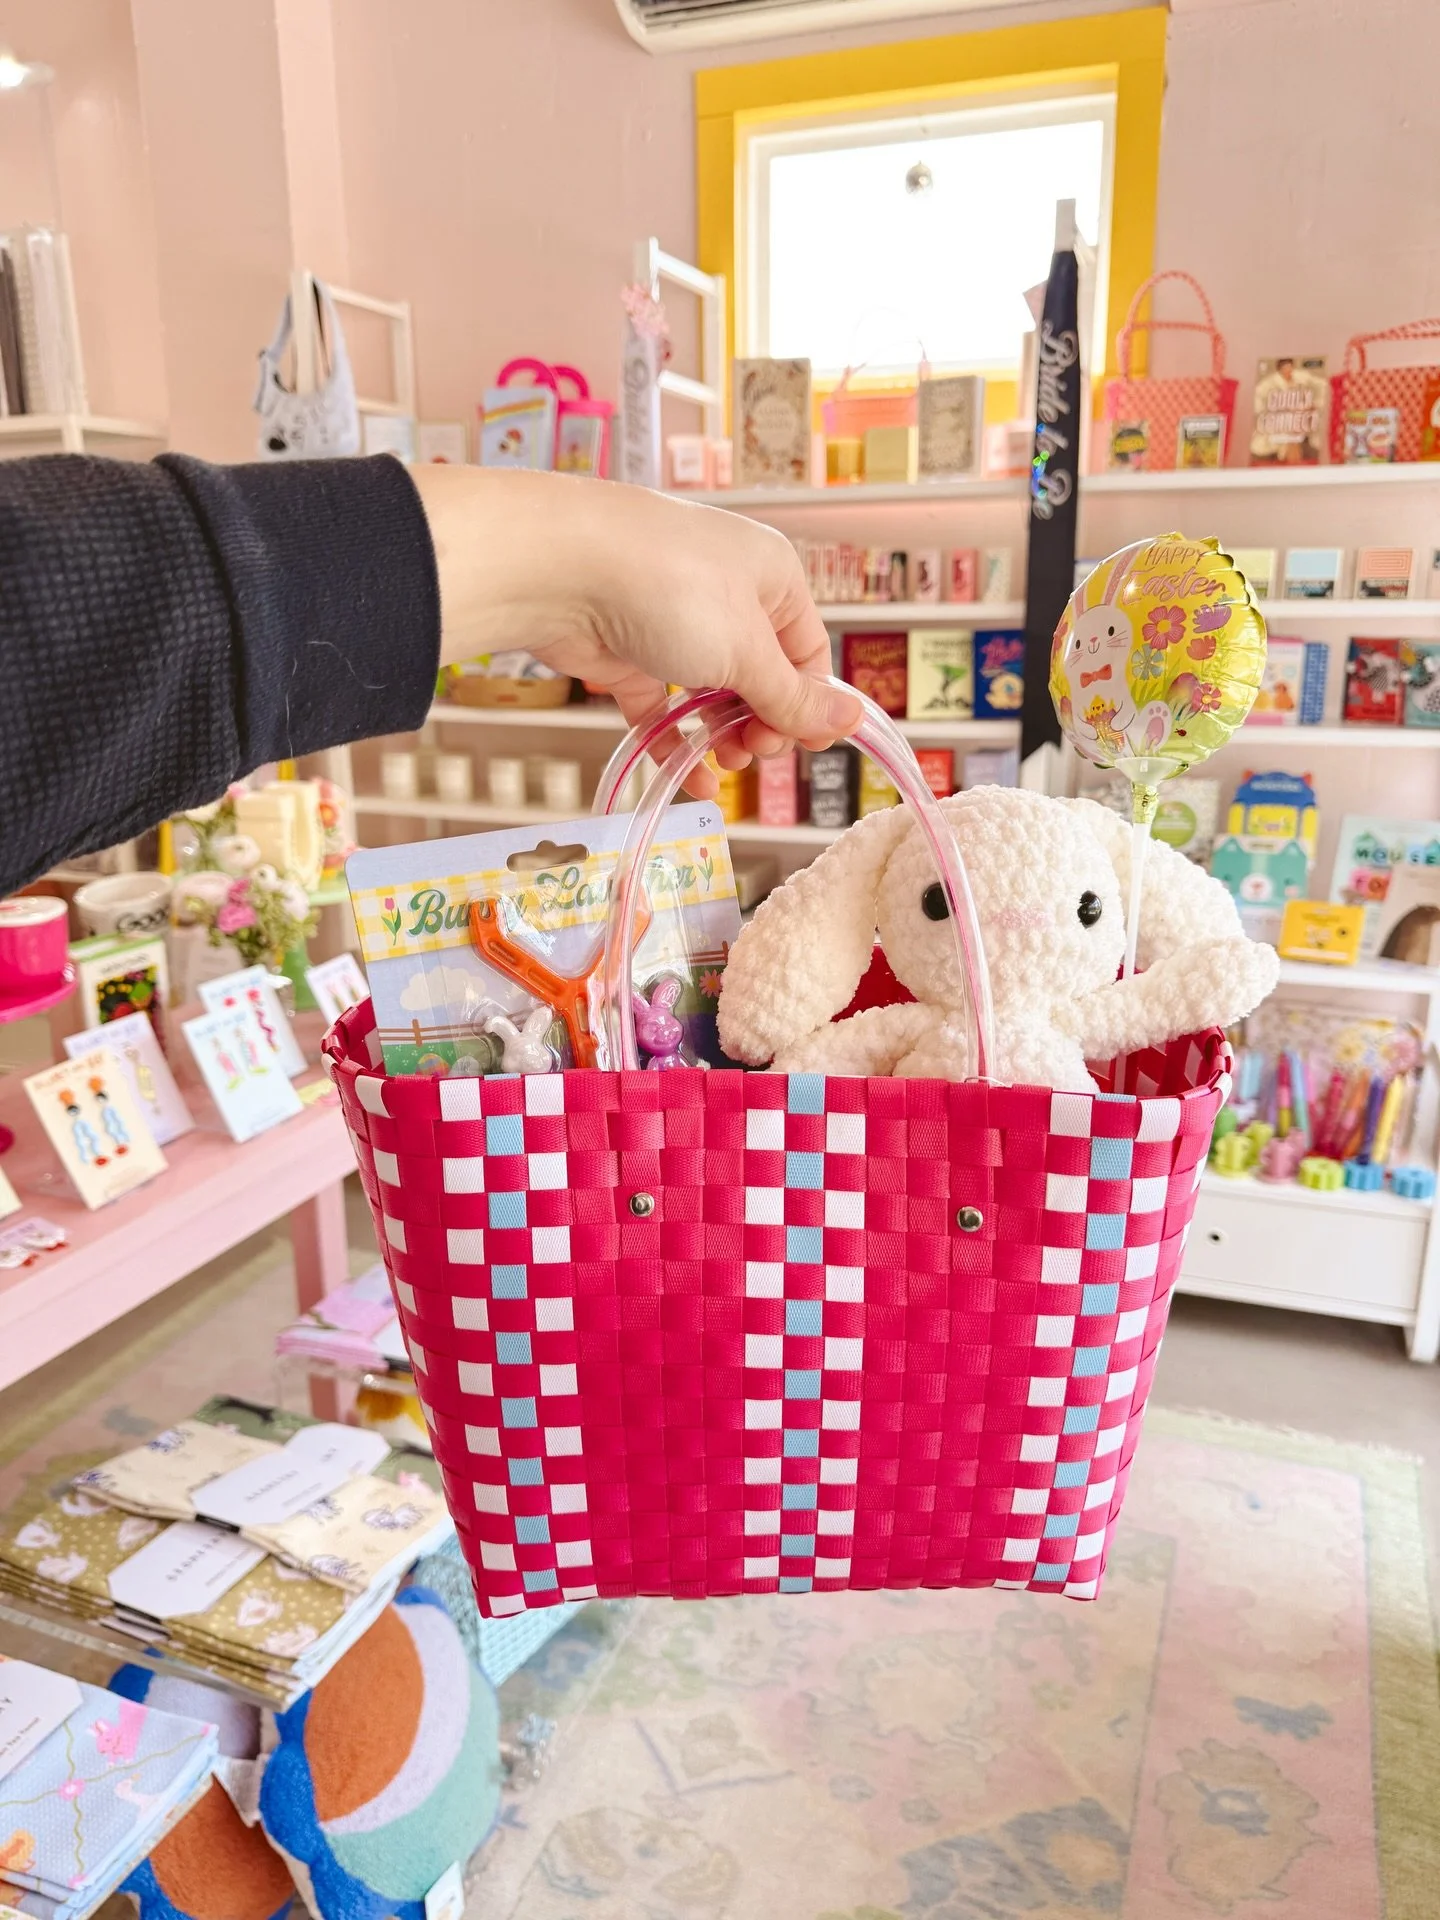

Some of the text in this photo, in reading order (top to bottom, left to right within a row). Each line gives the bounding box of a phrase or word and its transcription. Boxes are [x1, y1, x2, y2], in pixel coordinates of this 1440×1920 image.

[1037, 318, 1078, 423] Bride
[1144, 546, 1208, 566] HAPPY
[1122, 566, 1226, 605] Easter
[699, 816, 712, 828] 5+
[408, 889, 528, 935] Buy
